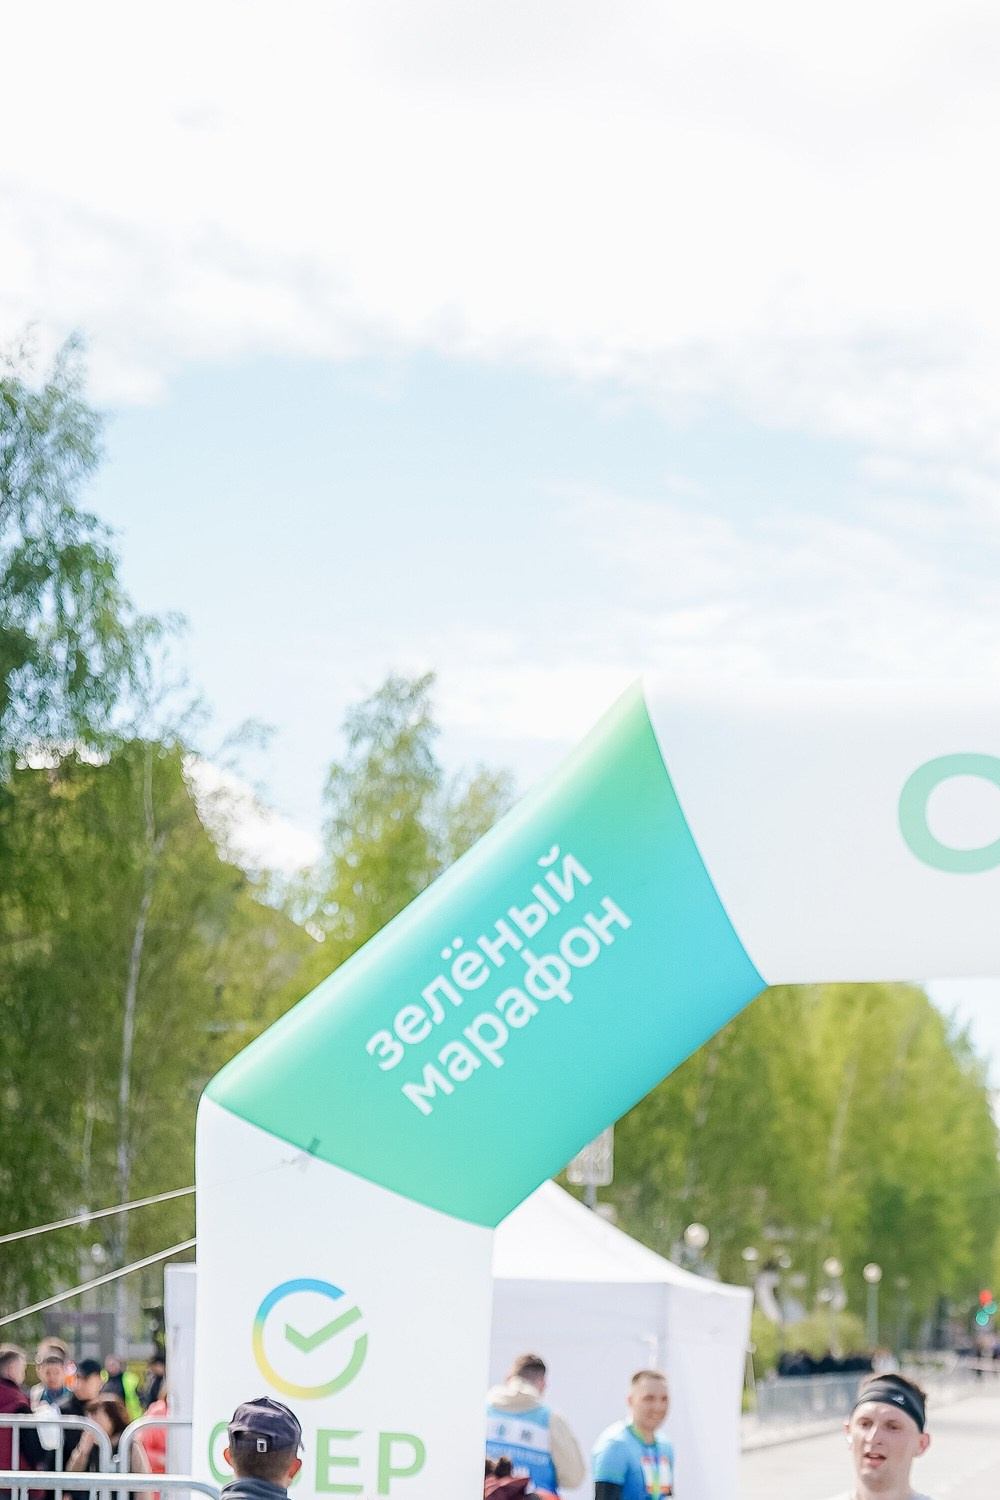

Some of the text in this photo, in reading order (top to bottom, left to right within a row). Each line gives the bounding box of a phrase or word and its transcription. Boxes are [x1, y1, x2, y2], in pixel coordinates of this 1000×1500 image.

[365, 844, 592, 1071] зелёный
[401, 895, 632, 1116] марафон
[208, 1421, 426, 1495] СЕР
